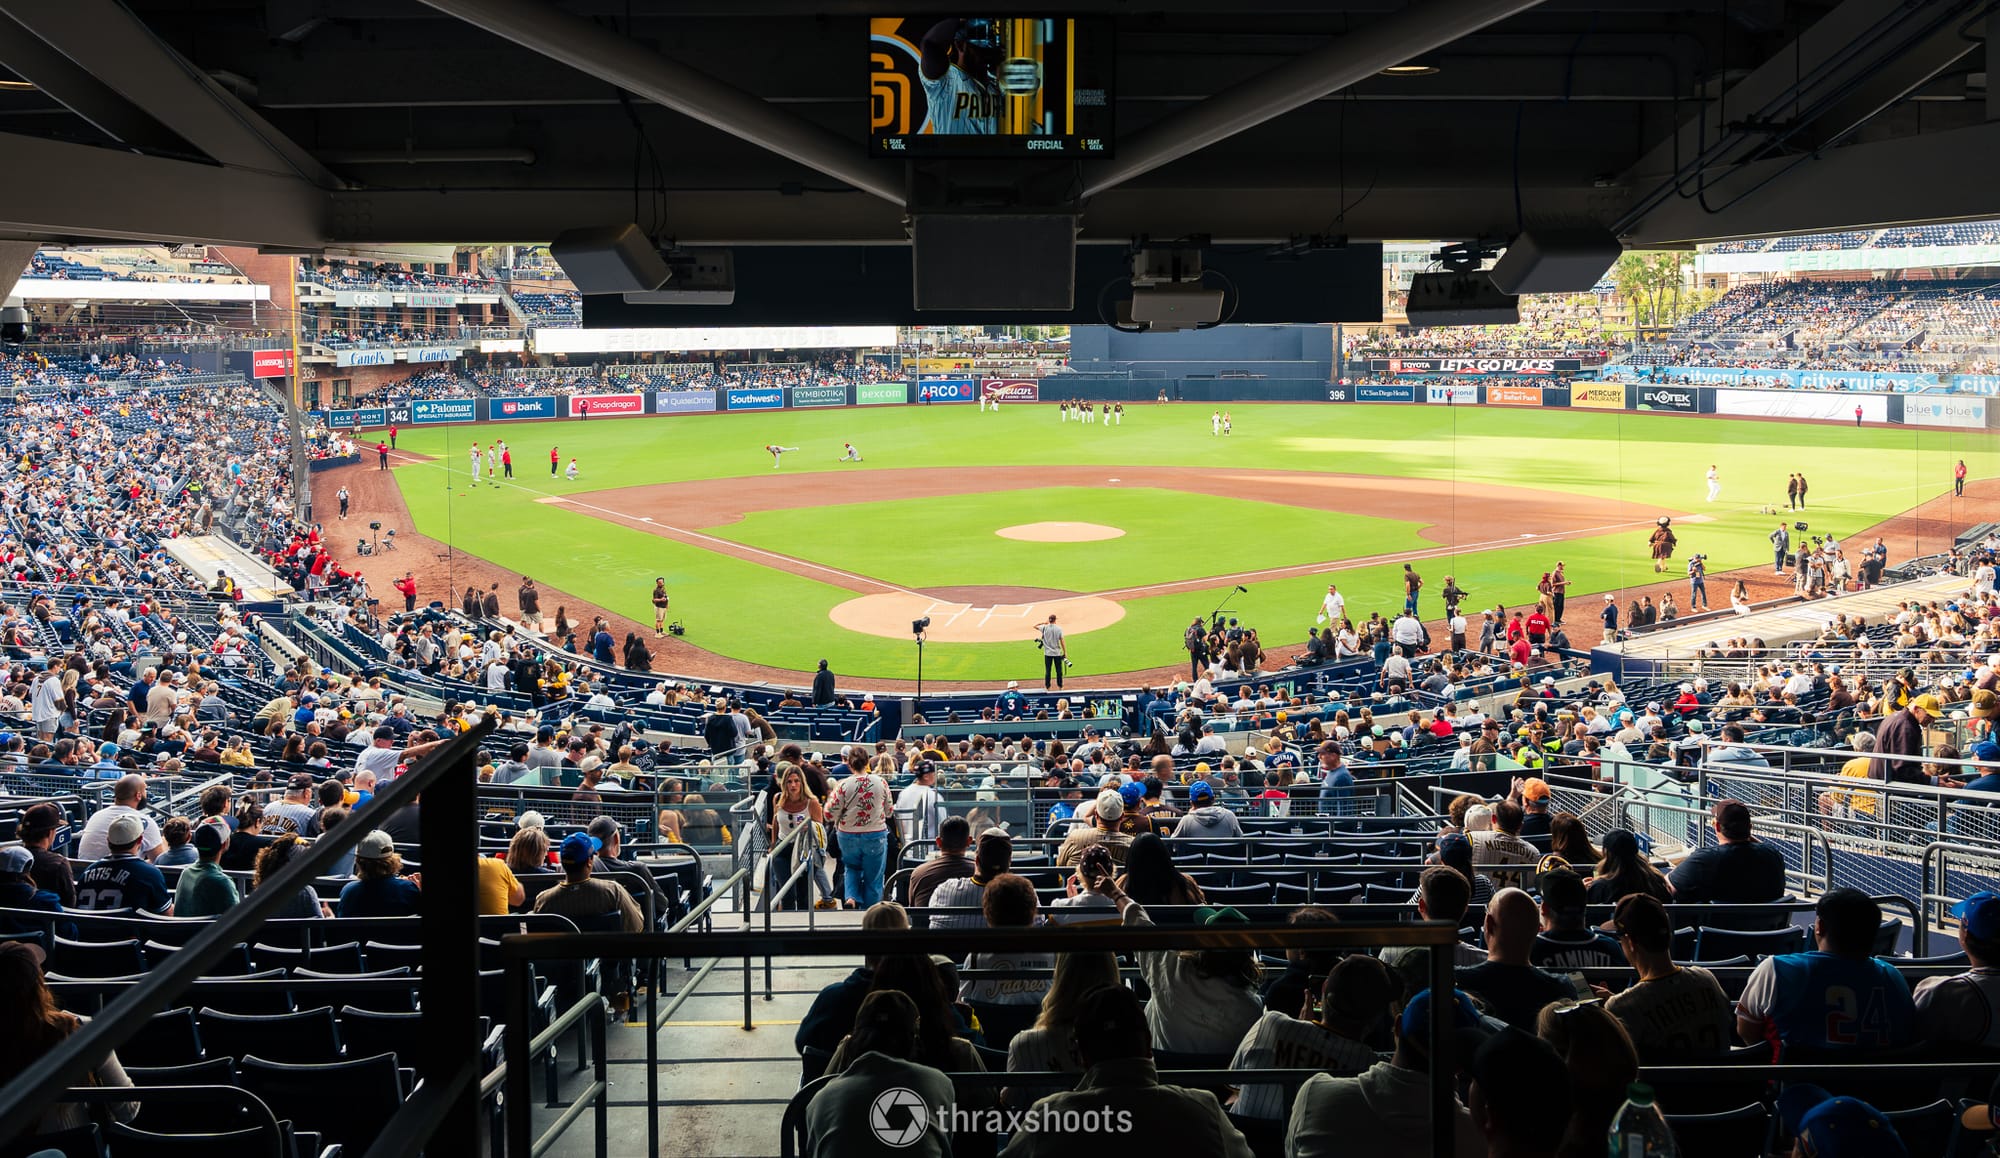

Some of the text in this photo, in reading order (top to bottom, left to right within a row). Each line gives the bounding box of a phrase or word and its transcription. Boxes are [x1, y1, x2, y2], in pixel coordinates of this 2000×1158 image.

[1027, 140, 1063, 150] OFFICIAL
[1440, 359, 1476, 371] LET'S
[1479, 359, 1501, 371] GO
[1503, 360, 1555, 371] PLACES
[302, 367, 316, 379] 336
[920, 386, 958, 397] ARCO
[1329, 390, 1346, 400] 396
[1644, 391, 1690, 403] EVOTEK
[592, 400, 636, 410] Snapdragon
[731, 395, 774, 405] Southwest
[431, 404, 472, 413] Palomar
[504, 402, 542, 412] us bank
[1906, 403, 1931, 414] blue
[1945, 405, 1971, 416] blue
[390, 410, 408, 422] 342
[1008, 698, 1015, 710] 3
[59, 833, 65, 843] G
[1485, 840, 1536, 861] MUSGROVE
[83, 867, 130, 885] TATIS JR.
[1647, 992, 1697, 1031] TATIS
[1825, 985, 1890, 1046] 24
